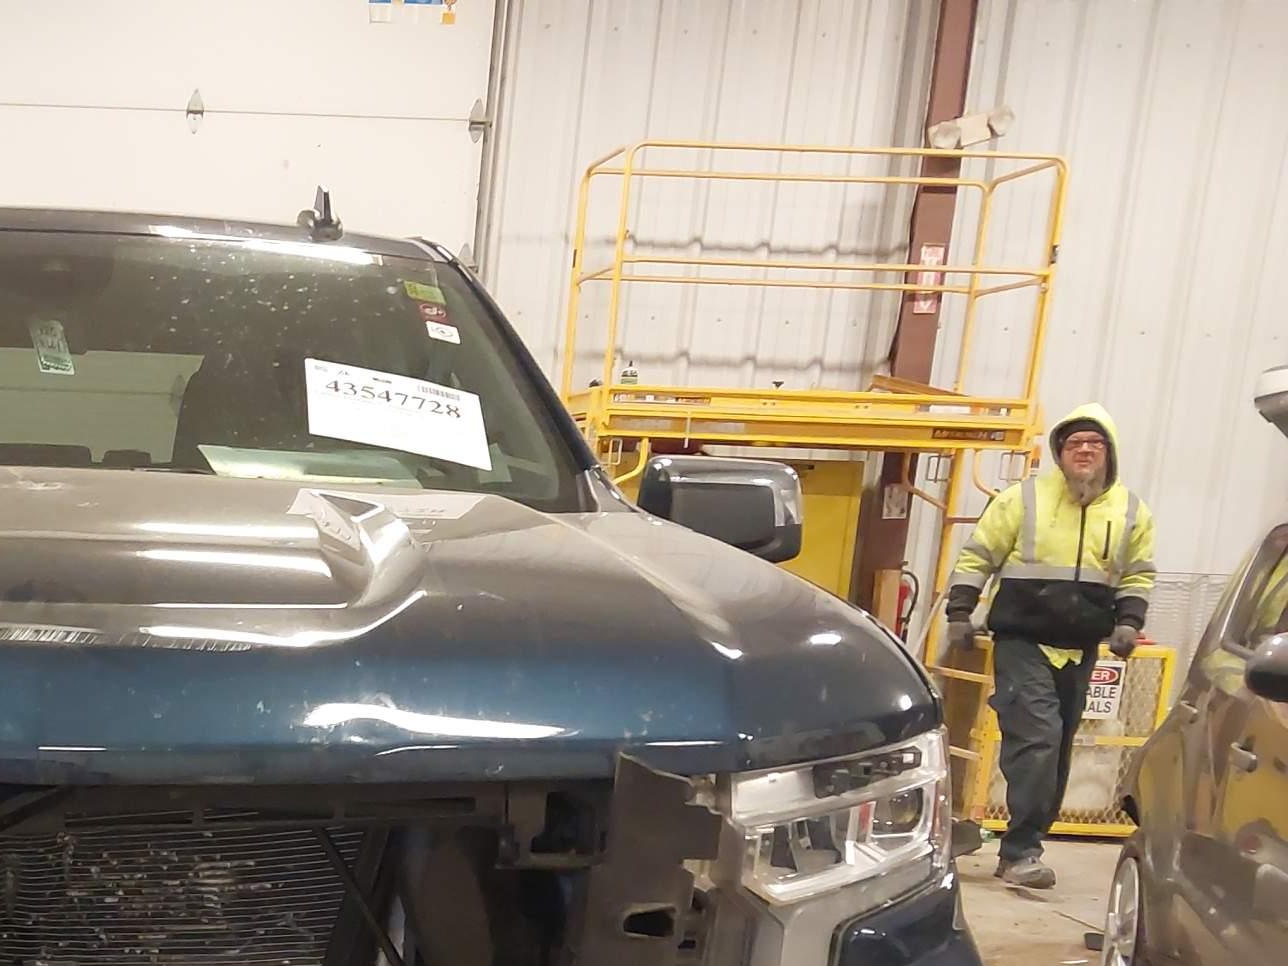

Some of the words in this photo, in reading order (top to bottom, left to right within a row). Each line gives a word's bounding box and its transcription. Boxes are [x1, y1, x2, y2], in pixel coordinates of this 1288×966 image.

[325, 380, 461, 418] 43547728
[1091, 670, 1111, 681] ER
[1085, 686, 1117, 699] ABLE
[1087, 701, 1112, 713] ALS
